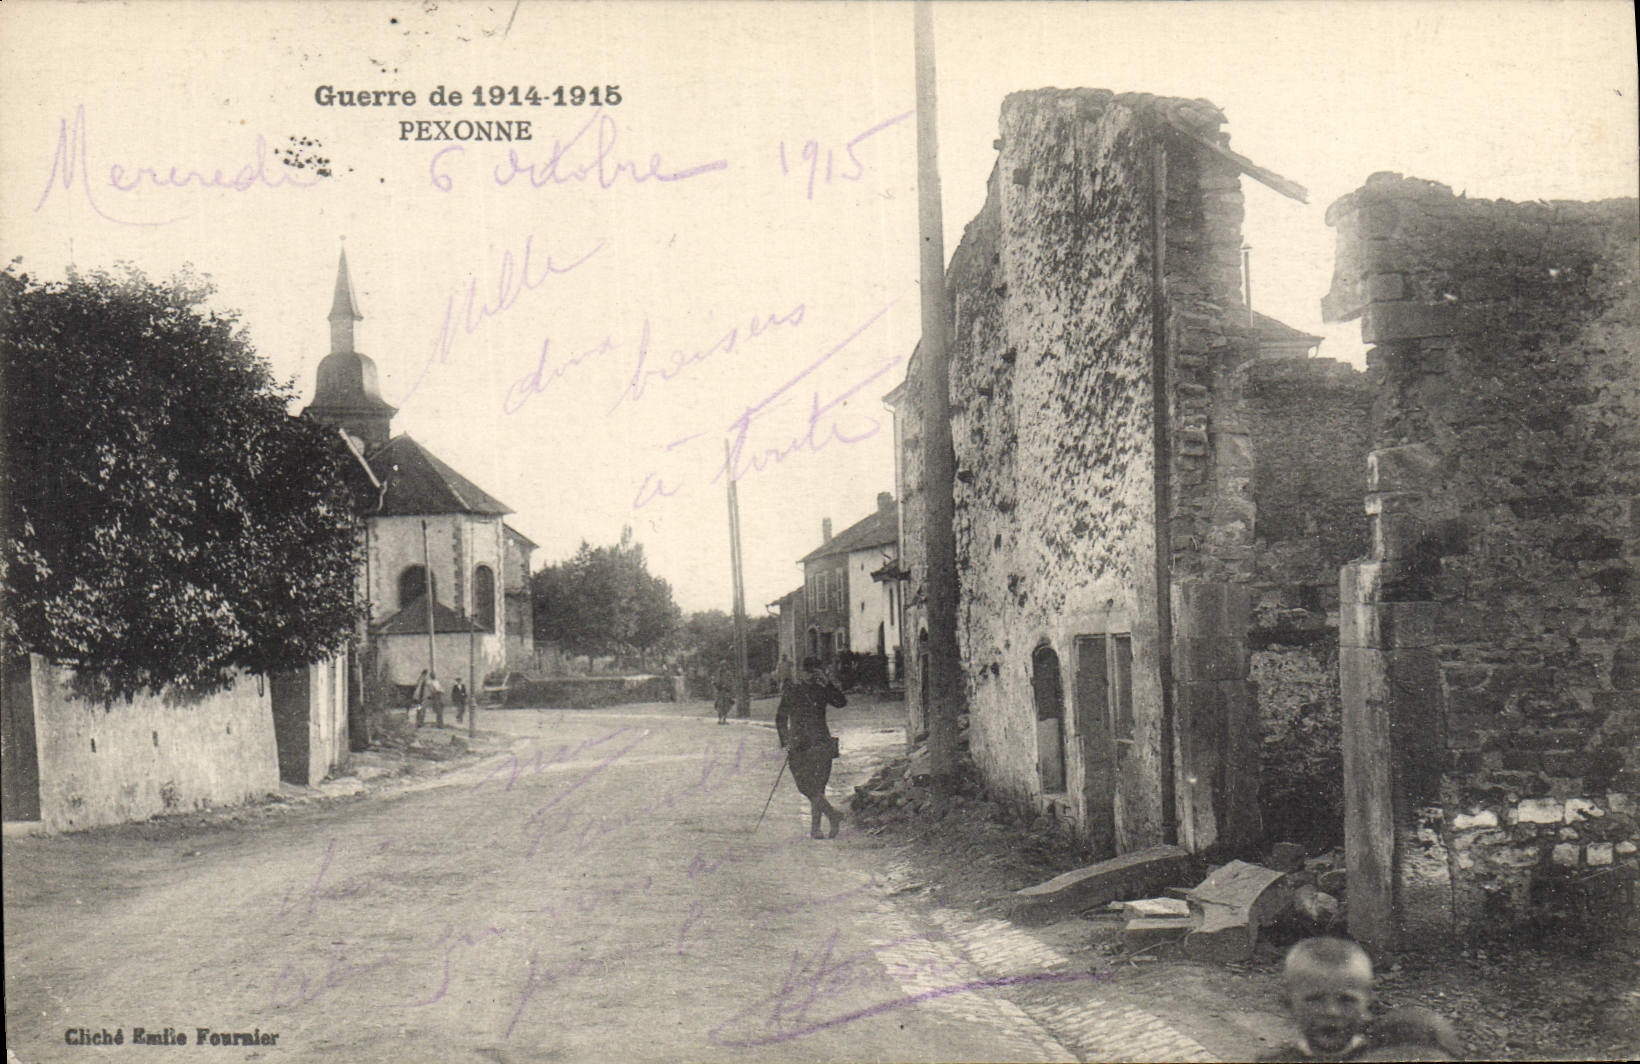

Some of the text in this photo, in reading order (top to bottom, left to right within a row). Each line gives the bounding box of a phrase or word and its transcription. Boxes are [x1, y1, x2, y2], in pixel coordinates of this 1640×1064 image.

[33, 103, 320, 226] Mercredi
[430, 146, 465, 191] 6
[780, 110, 915, 201] 1915
[400, 234, 606, 405] Mille
